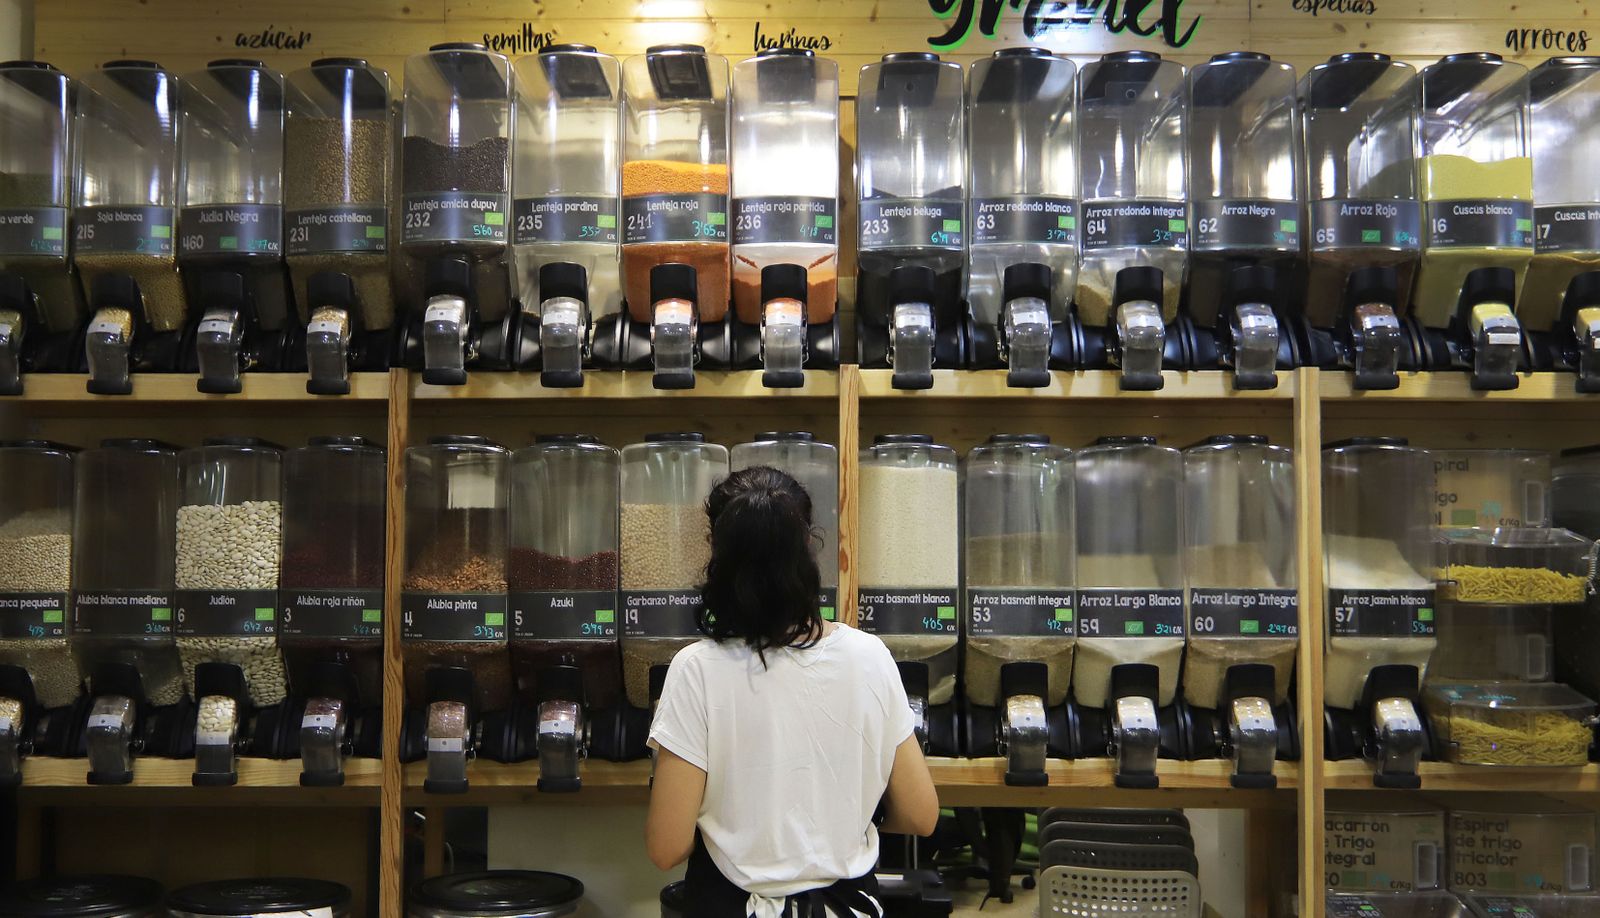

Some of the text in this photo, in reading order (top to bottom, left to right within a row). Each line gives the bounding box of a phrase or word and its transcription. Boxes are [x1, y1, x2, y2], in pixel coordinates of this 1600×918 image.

[236, 24, 311, 50] azúcar
[483, 22, 556, 54] semillas
[754, 21, 832, 51] harinas
[1505, 28, 1592, 53] arroces
[410, 199, 498, 212] Lenteja amicia dupuy
[532, 202, 599, 214] Lenteja pardina
[647, 201, 699, 212] Lenteja roja
[741, 202, 825, 214] Lenteja roja partida
[880, 206, 942, 218] Lenteja beluga
[979, 202, 1072, 214] Arroz redondo blanco
[1086, 206, 1184, 219] Arroz redondo integral
[1221, 205, 1276, 218] Arroz Negro
[1341, 204, 1397, 218] Arroz Rojo
[1486, 205, 1514, 216] blanco
[8, 214, 34, 224] verde
[97, 211, 144, 223] Soja blanca
[225, 210, 259, 225] Negra
[298, 213, 372, 226] Lenteja castellana
[406, 212, 431, 229] 232
[518, 215, 543, 231] 235
[628, 213, 654, 230] 241
[737, 215, 762, 231] 236
[976, 215, 996, 231] 63
[1199, 217, 1218, 233] 62
[78, 224, 95, 240] 215
[692, 220, 717, 237] 3'65
[863, 219, 890, 235] 233
[1087, 218, 1107, 235] 64
[1432, 218, 1448, 234] 16
[1536, 224, 1552, 240] 17
[183, 235, 204, 250] 460
[290, 227, 309, 242] 231
[1316, 228, 1336, 243] 65
[20, 597, 59, 610] pequeña
[77, 595, 168, 605] Alubia blanca mediana
[297, 595, 365, 608] Alubia roja riñón
[427, 599, 478, 612] Alubia pinta
[550, 597, 574, 608] Azuki
[627, 596, 667, 607] Garbanzo
[859, 593, 951, 605] Arroz basmati blanco
[973, 594, 1071, 608] Arroz basmati integral
[1080, 594, 1182, 609] Arroz Largo Blanco
[1192, 592, 1223, 605] Arroz
[1224, 592, 1256, 608] Largo
[1342, 594, 1369, 606] Arroz
[1400, 594, 1426, 606] blanco
[177, 607, 187, 623] 6
[284, 607, 292, 623] 3
[404, 610, 413, 627] 4
[514, 609, 523, 626] 5
[625, 608, 639, 625] 19
[857, 605, 874, 622] 52
[973, 607, 992, 623] 53
[1335, 607, 1354, 623] 57
[922, 616, 943, 632] 4'05
[1080, 618, 1100, 635] 59
[1195, 616, 1215, 632] 60
[1455, 817, 1509, 835] Espiral
[1334, 835, 1375, 852] Trigo
[1455, 832, 1523, 853] de trigo
[1455, 849, 1519, 867] tricolor
[1455, 871, 1487, 888] 803
